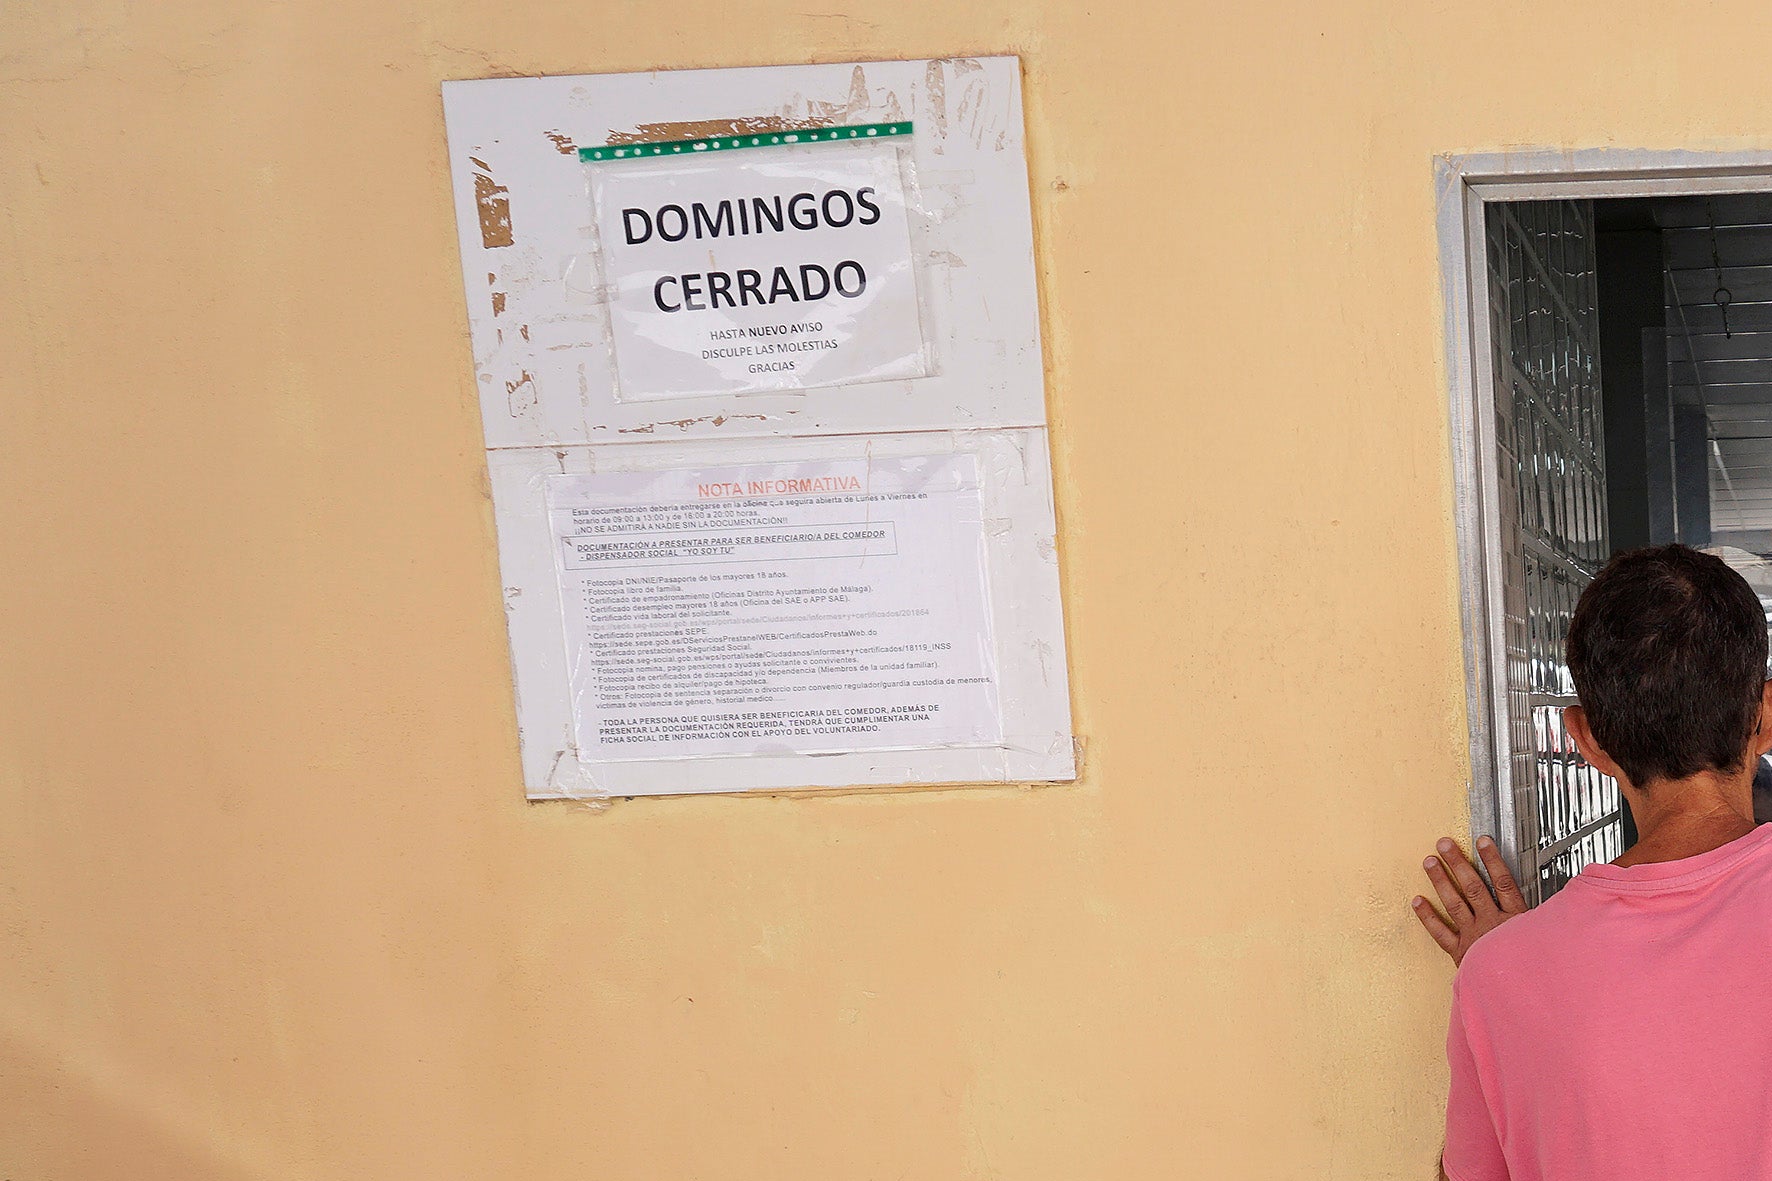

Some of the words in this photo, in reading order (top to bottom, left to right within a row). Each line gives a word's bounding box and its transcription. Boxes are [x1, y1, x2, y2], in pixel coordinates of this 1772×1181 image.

[622, 187, 881, 245] DOMINGOS
[654, 260, 867, 313] CERRADO
[710, 328, 746, 340] HASTA
[748, 324, 787, 337] NUEVO
[790, 321, 823, 334] AVISO
[702, 346, 753, 360] DISCULPE
[755, 344, 774, 355] LAS
[777, 339, 838, 353] MOLESTIAS
[748, 361, 795, 374] GRACIAS
[698, 483, 744, 497] NOTA
[748, 477, 861, 494] INFORMATIVA
[655, 522, 681, 530] NADIE
[577, 540, 650, 550] DOCUMENTACIÓN
[658, 538, 710, 547] PRESENTAR
[842, 530, 886, 538] COMEDOR
[586, 551, 646, 559] DISPENSADOR
[599, 727, 648, 735] PRESENTAR
[662, 722, 735, 732] DOCUMENTACIÓN
[844, 714, 910, 724] CUMPLIMENTAR
[639, 717, 680, 725] PERSONA
[700, 714, 740, 722] QUISIERA
[626, 735, 657, 743] SOCIAL
[672, 730, 731, 741] INFORMACIÓN
[812, 725, 881, 734] VOLUNTARIADO.
